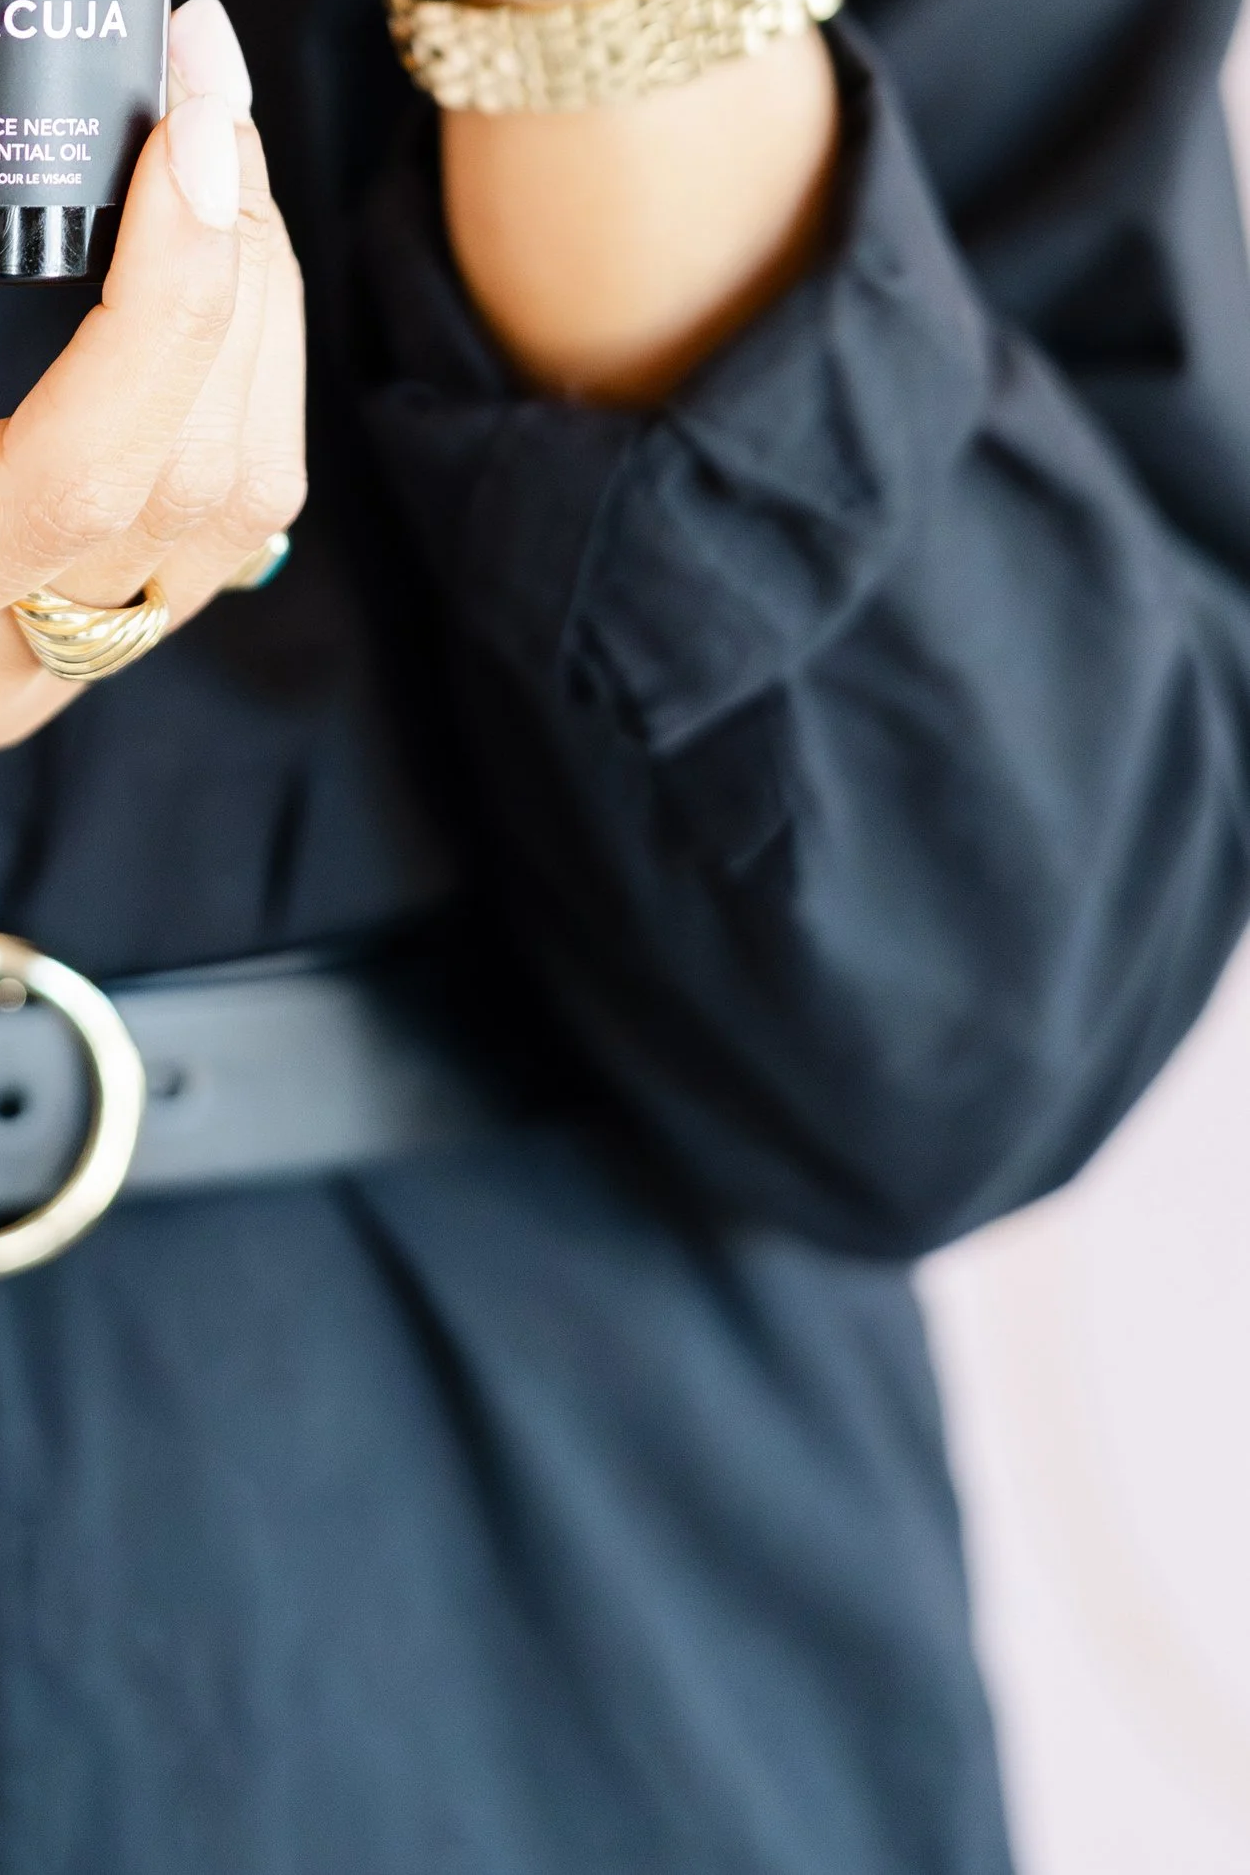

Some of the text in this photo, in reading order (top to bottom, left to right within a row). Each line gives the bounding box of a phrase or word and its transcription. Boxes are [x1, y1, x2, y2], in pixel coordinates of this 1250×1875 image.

[23, 118, 100, 137] NECTAR
[59, 143, 92, 162] OIL
[26, 173, 40, 185] LE
[41, 173, 82, 185] VISAGE
